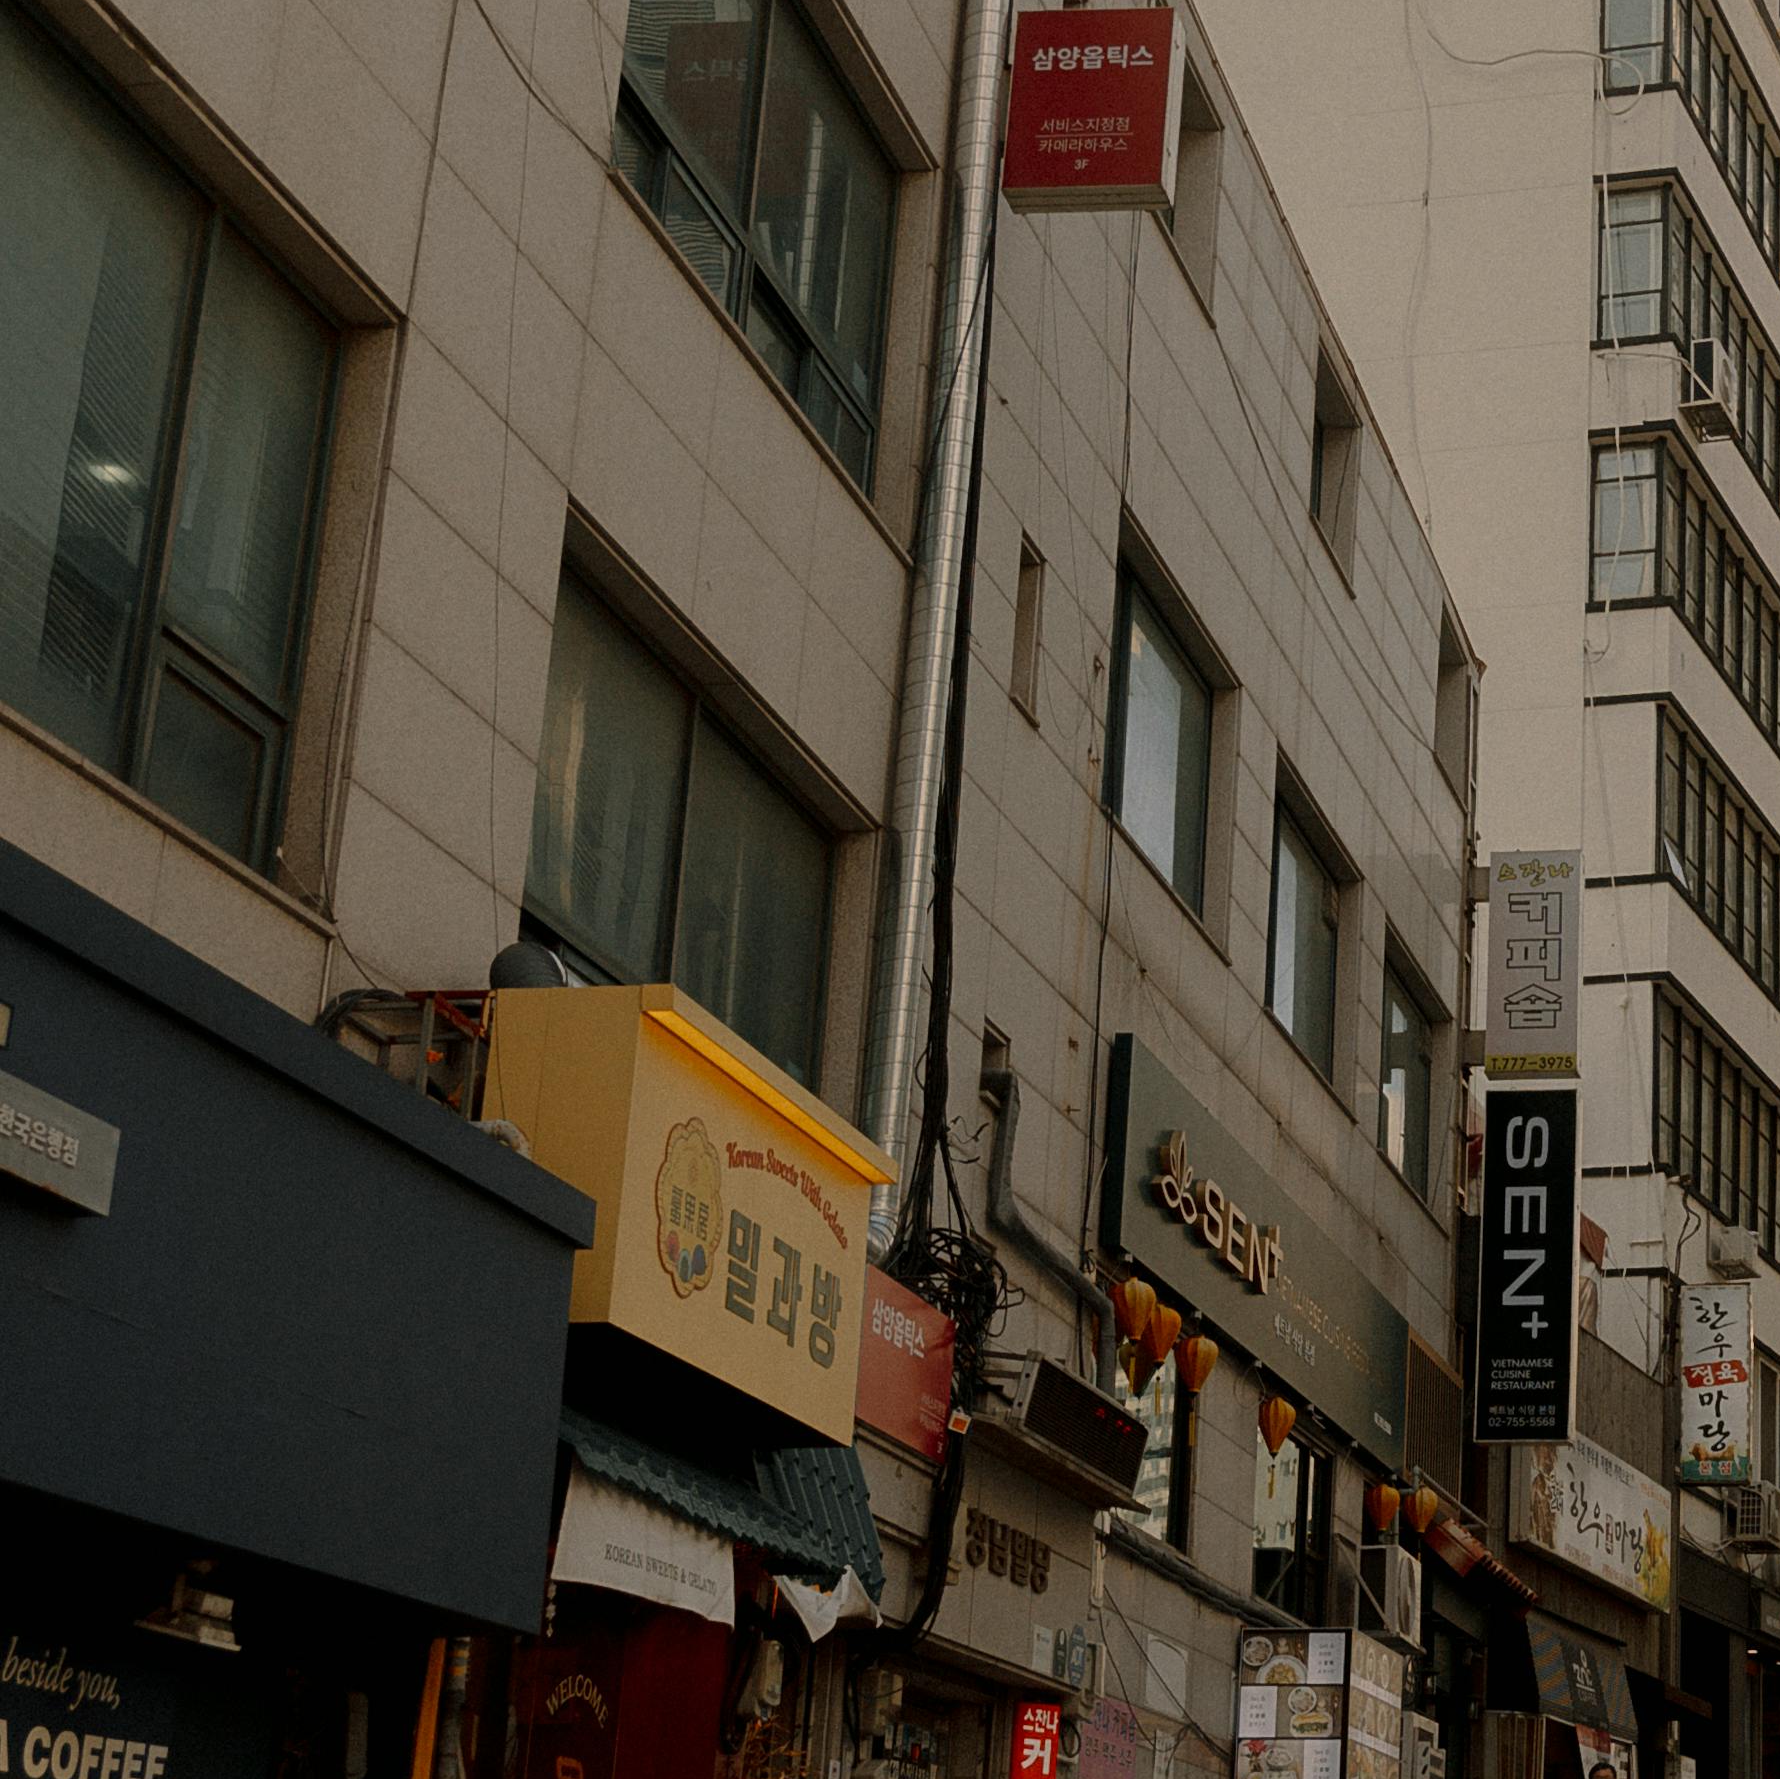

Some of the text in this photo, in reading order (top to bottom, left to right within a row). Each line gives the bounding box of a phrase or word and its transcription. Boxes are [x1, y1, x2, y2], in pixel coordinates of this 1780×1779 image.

[1032, 43, 1154, 71] 삼양옵틱스
[1040, 117, 1130, 133] 서비스지정점
[1038, 137, 1129, 153] 카메라하우스
[1074, 159, 1090, 171] 3F
[1504, 892, 1563, 1030] 커피숍
[1491, 1056, 1573, 1070] T.777-3975
[726, 1142, 848, 1250] Korean Sweets With Gelato
[725, 1209, 842, 1369] 밀과방
[872, 1298, 924, 1358] 삼양옵틱스
[1689, 1296, 1738, 1358] 한우
[1491, 1357, 1554, 1369] VIETNAMESE
[1491, 1369, 1531, 1380] CUISINE
[1691, 1362, 1739, 1386] 정육
[1491, 1380, 1556, 1391] RESTAURANT
[1698, 1391, 1730, 1451] 마당
[604, 1543, 643, 1570] KOREAN
[645, 1555, 679, 1581] SWEETS
[2, 1635, 121, 1713] beside you,
[545, 1673, 609, 1730] WELCOME
